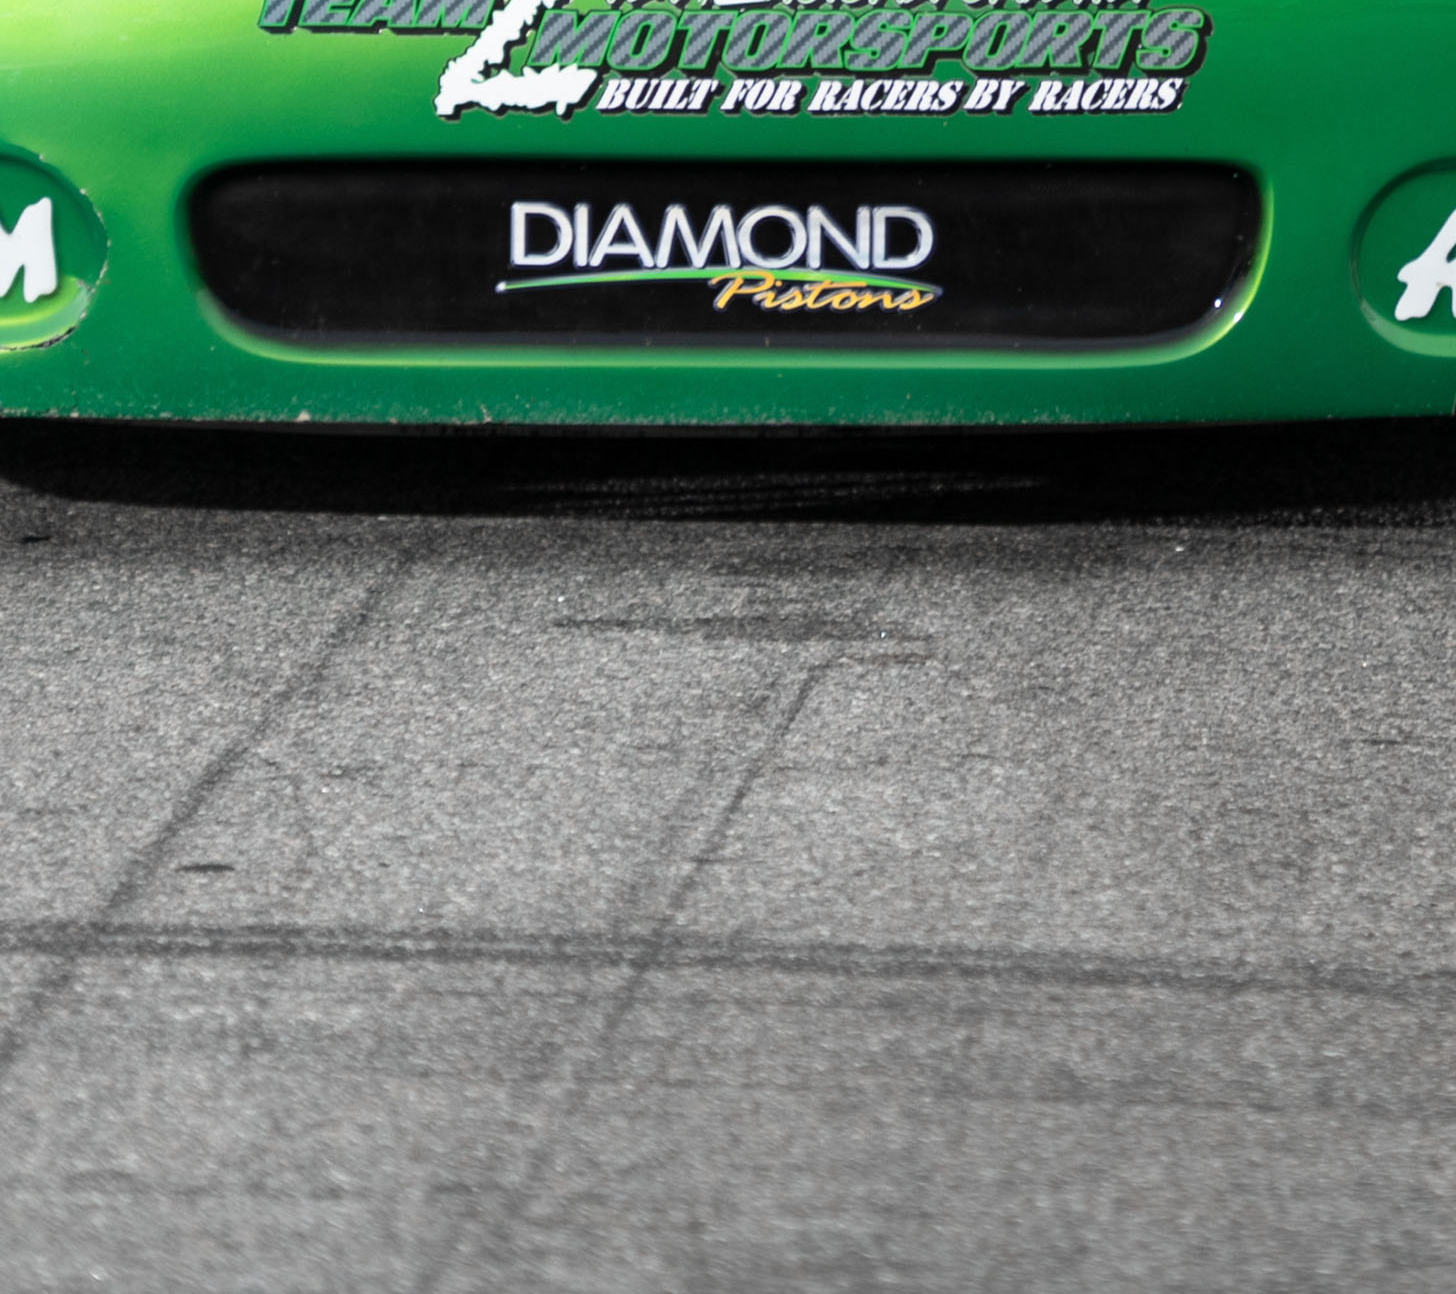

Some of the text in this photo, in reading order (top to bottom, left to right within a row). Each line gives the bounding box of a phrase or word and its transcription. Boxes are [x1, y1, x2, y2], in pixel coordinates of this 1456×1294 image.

[527, 10, 1204, 71] MOTORSPORTS
[596, 78, 1184, 111] BUILT FOR RACERS BY RACERS
[510, 201, 935, 270] DIAMOND
[709, 269, 934, 312] Pistons
